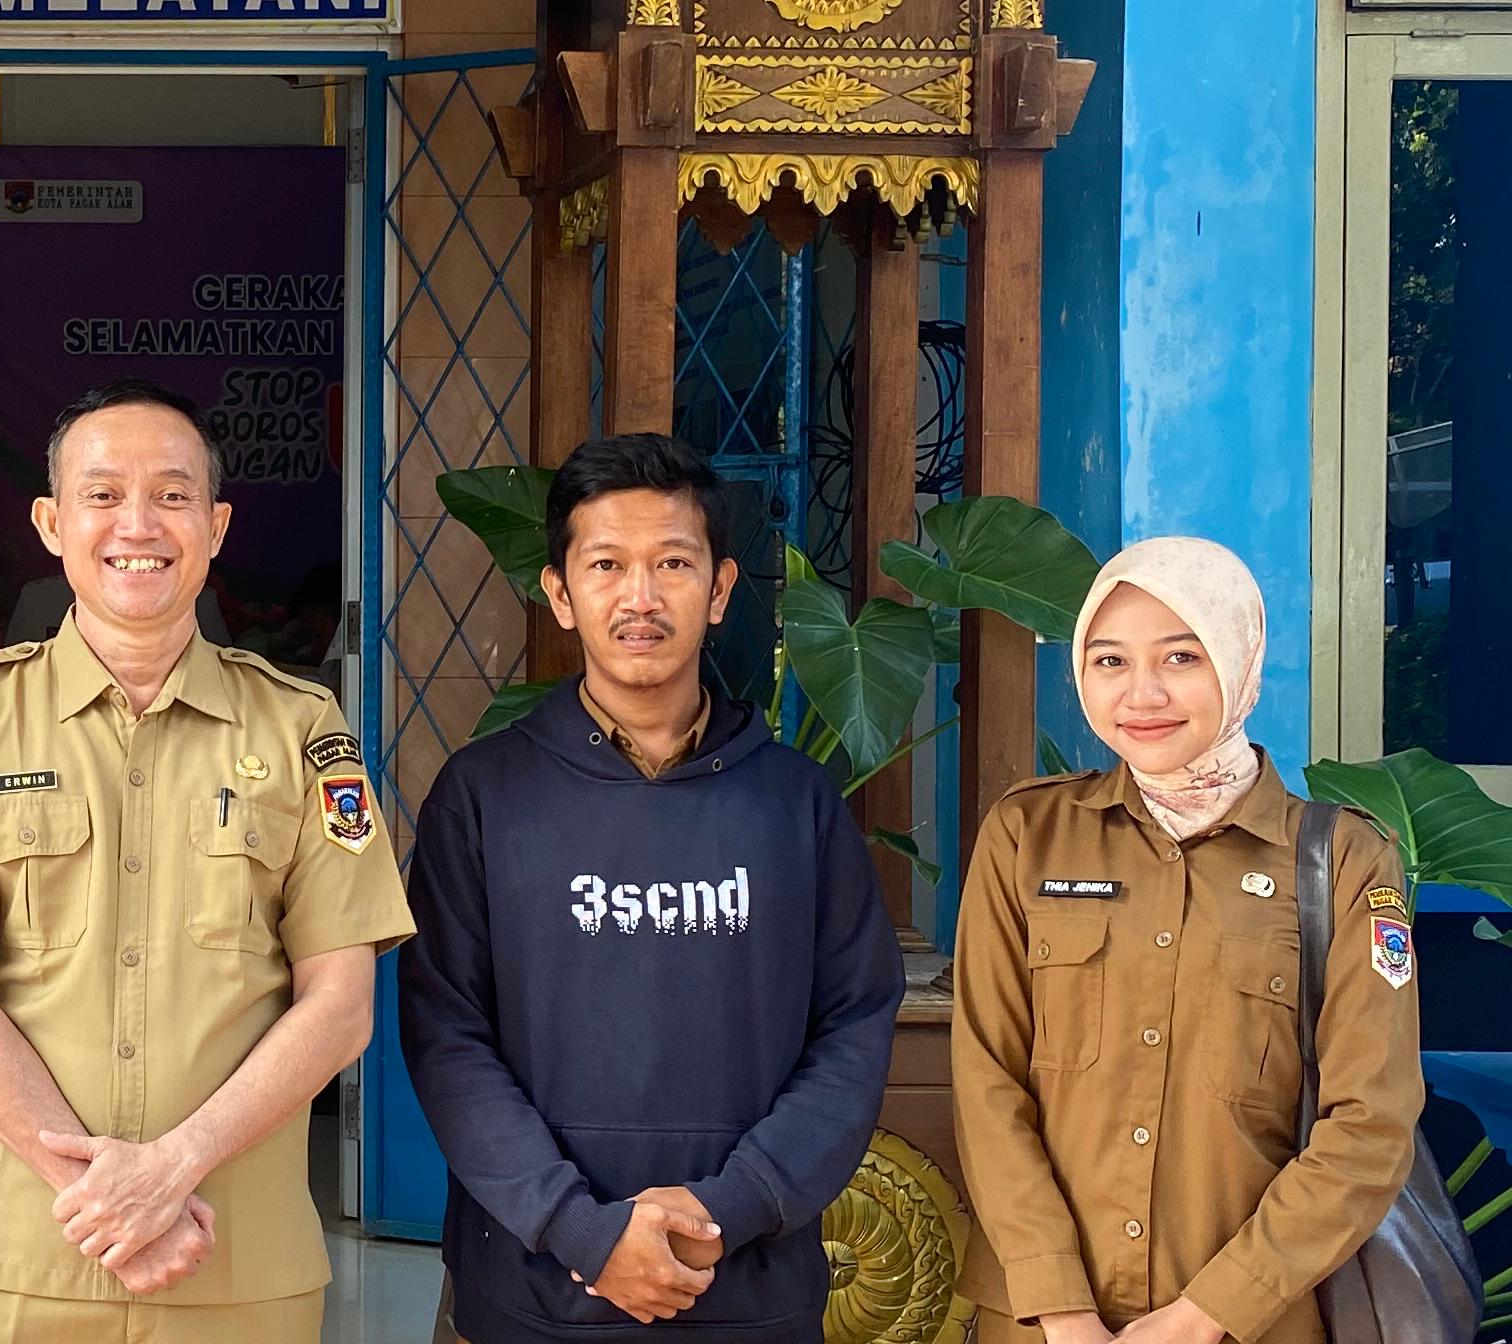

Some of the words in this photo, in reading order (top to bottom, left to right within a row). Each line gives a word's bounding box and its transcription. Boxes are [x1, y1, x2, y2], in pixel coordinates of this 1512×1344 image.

[63, 318, 334, 355] SELAMATKAN
[222, 367, 322, 408] STOP
[4, 774, 46, 788] ERWIN
[570, 866, 750, 937] 3scnd
